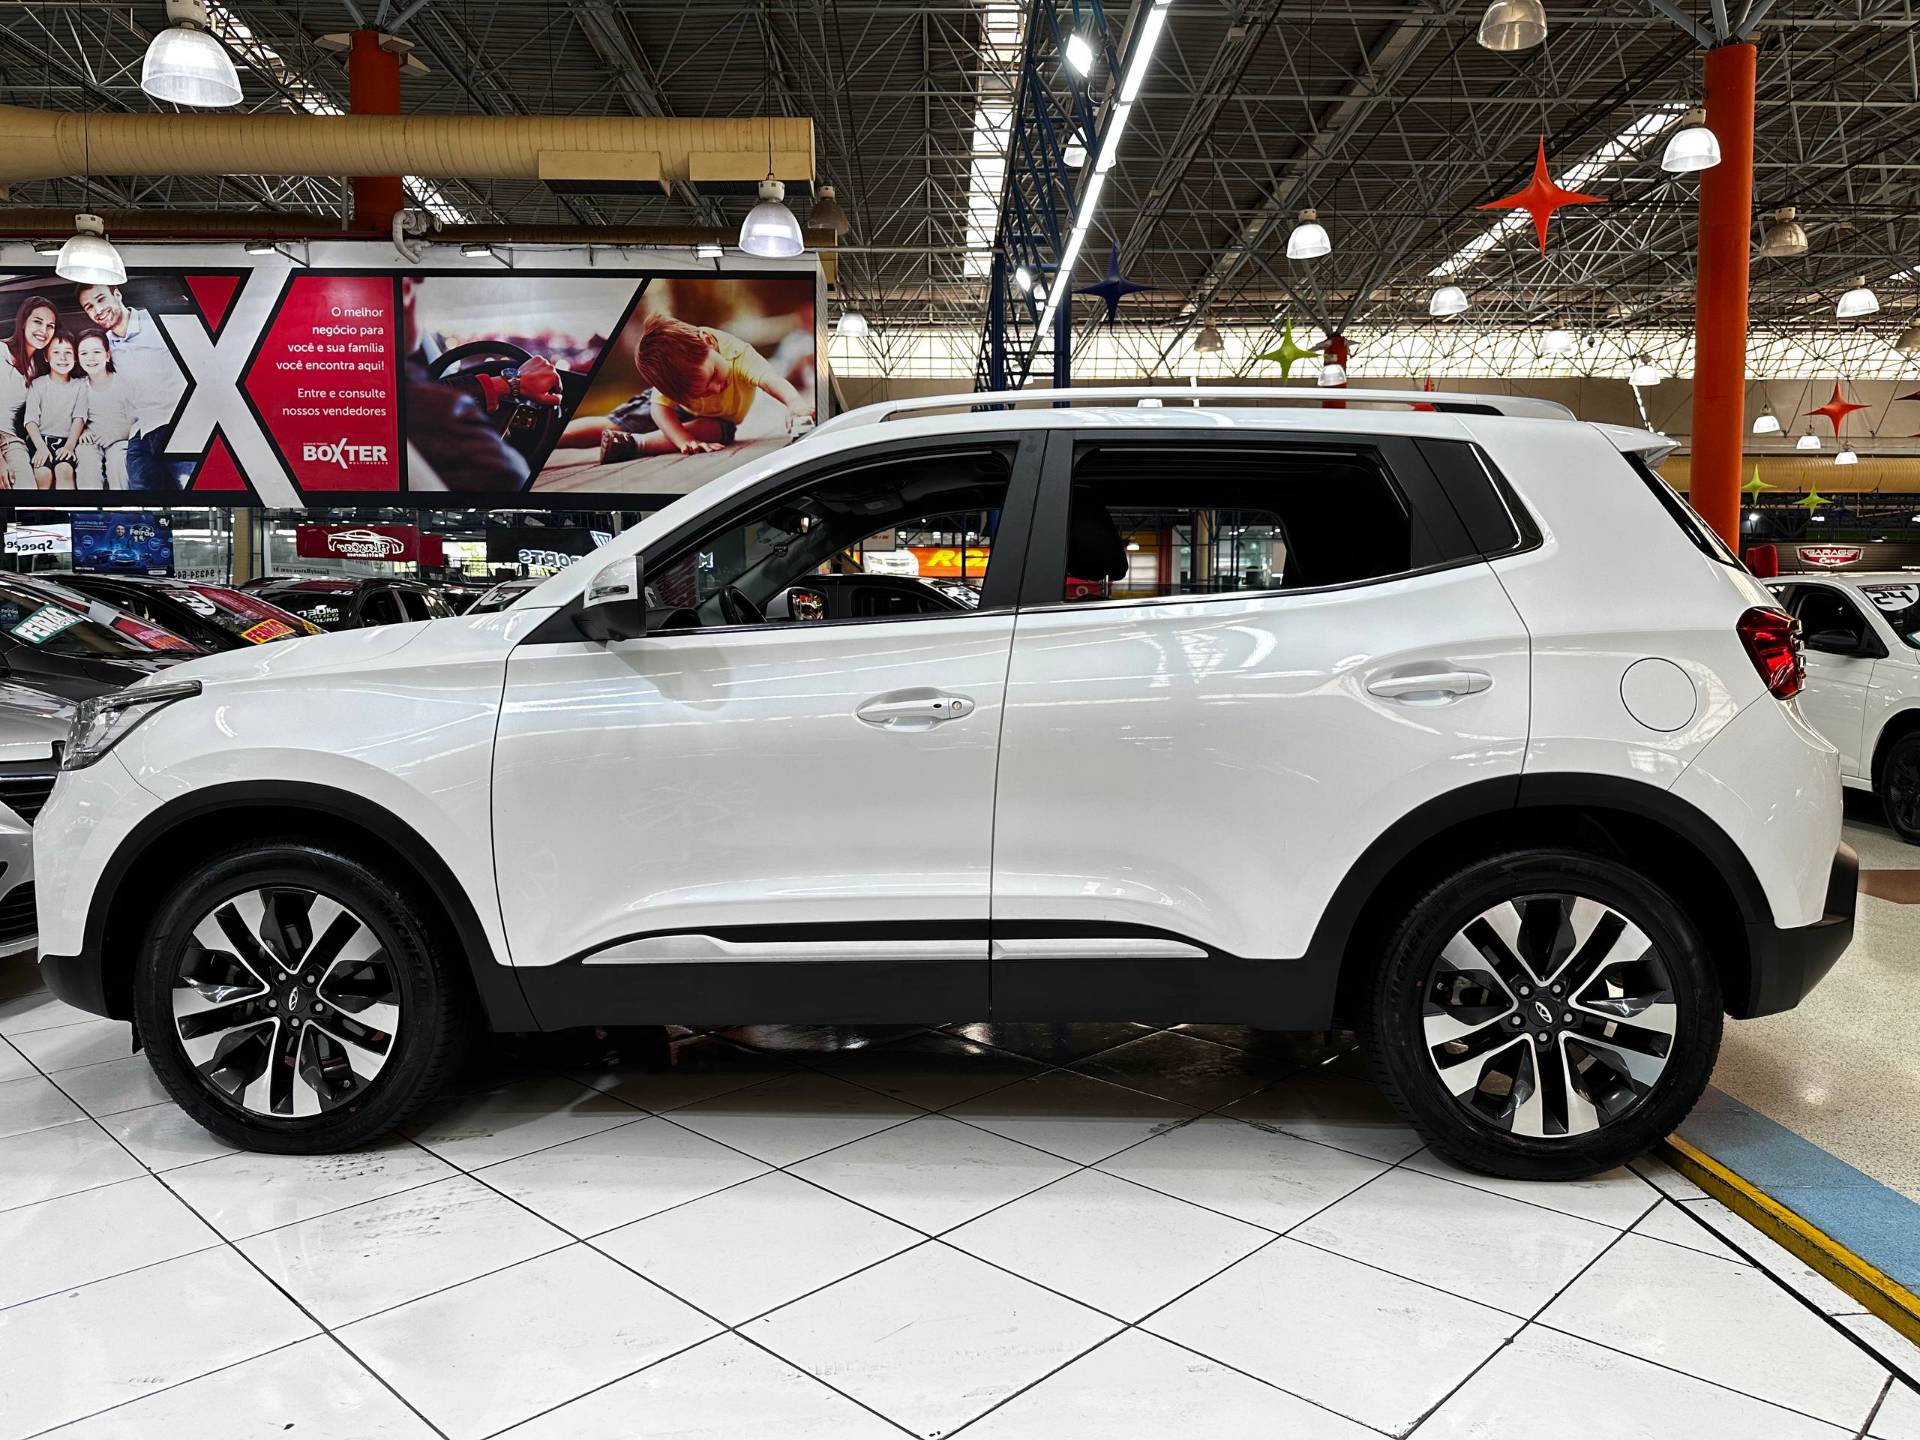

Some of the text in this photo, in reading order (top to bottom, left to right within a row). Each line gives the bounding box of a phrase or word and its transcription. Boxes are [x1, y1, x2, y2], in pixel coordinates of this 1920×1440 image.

[331, 306, 384, 317] O melhor
[312, 325, 384, 337] negócio para
[287, 342, 384, 353] você e sua família
[276, 360, 384, 372] você encontra aqui!
[297, 388, 386, 398] Entre e consulte
[282, 406, 387, 416] nossos vendedores
[303, 438, 388, 469] BOXTER
[1807, 549, 1855, 557] GARAGE
[1867, 591, 1914, 605] 24
